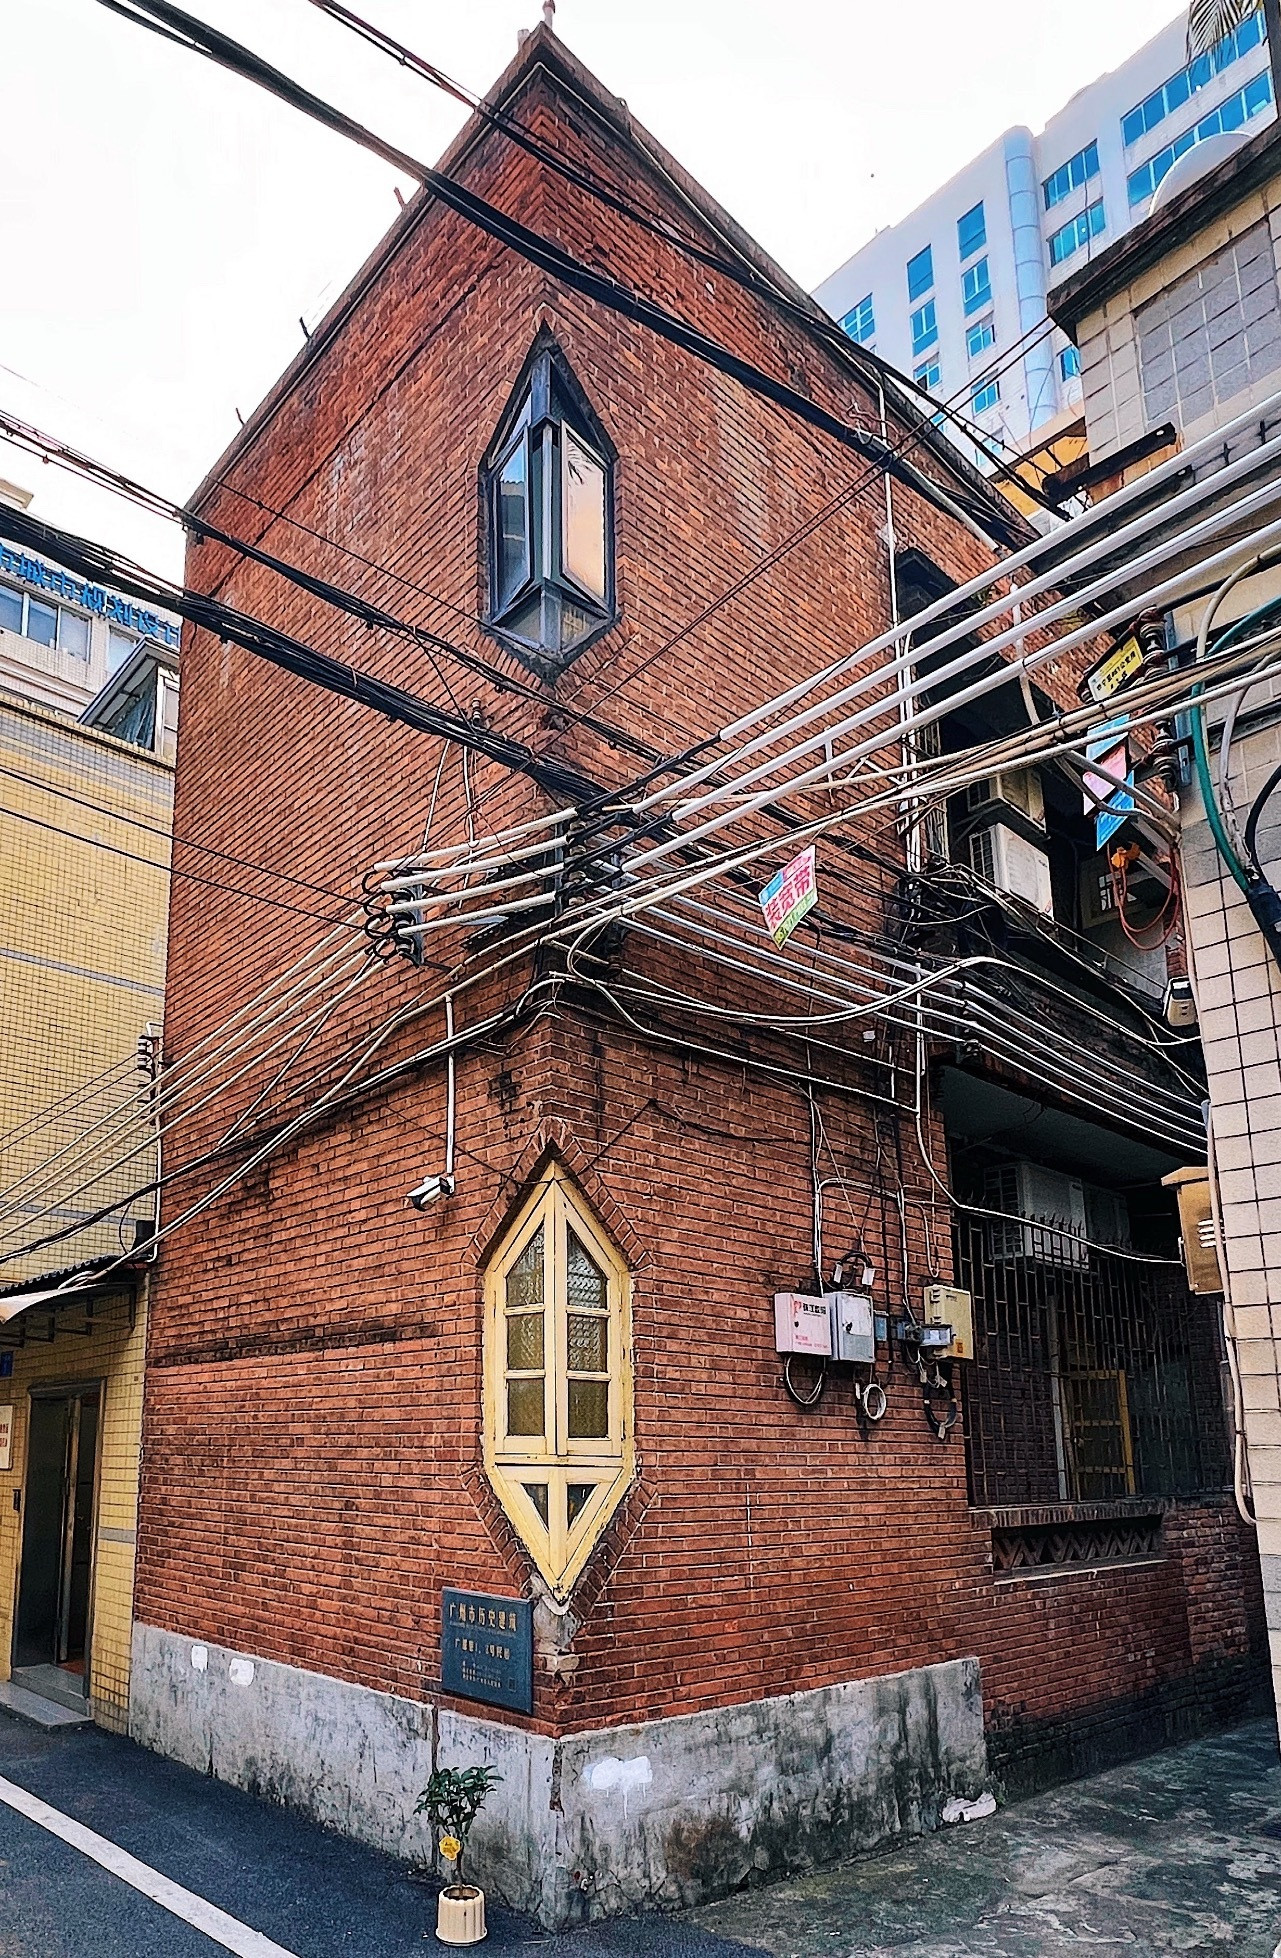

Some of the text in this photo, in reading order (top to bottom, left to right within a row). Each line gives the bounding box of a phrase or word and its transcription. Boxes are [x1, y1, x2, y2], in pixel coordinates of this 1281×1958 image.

[449, 1602, 517, 1631] 广州市历史建筑
